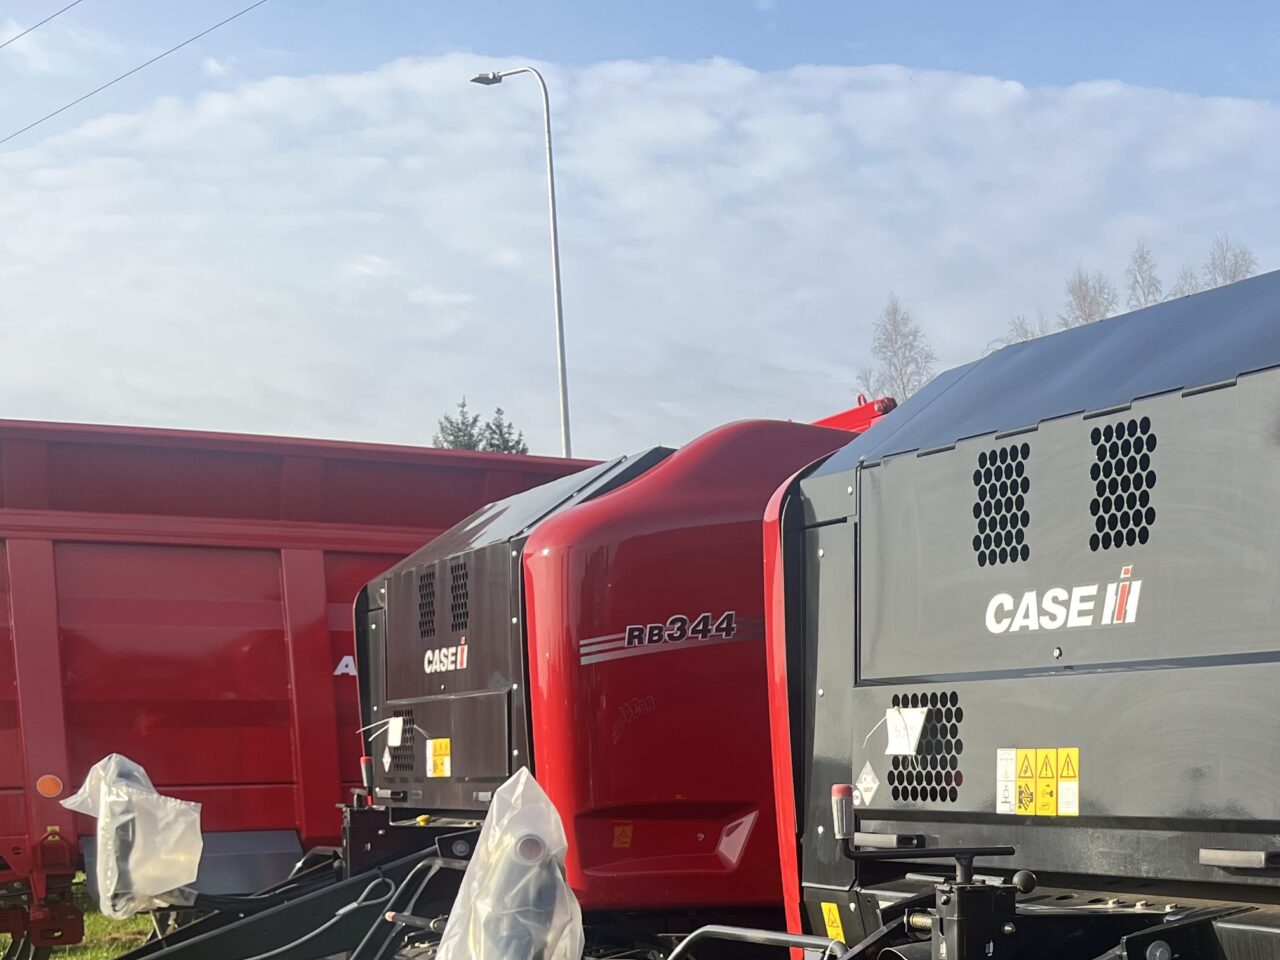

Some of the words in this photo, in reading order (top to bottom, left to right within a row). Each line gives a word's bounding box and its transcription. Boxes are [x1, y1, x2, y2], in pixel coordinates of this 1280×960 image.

[985, 584, 1098, 634] CASE
[624, 610, 737, 648] RB344
[423, 647, 456, 674] CASE
